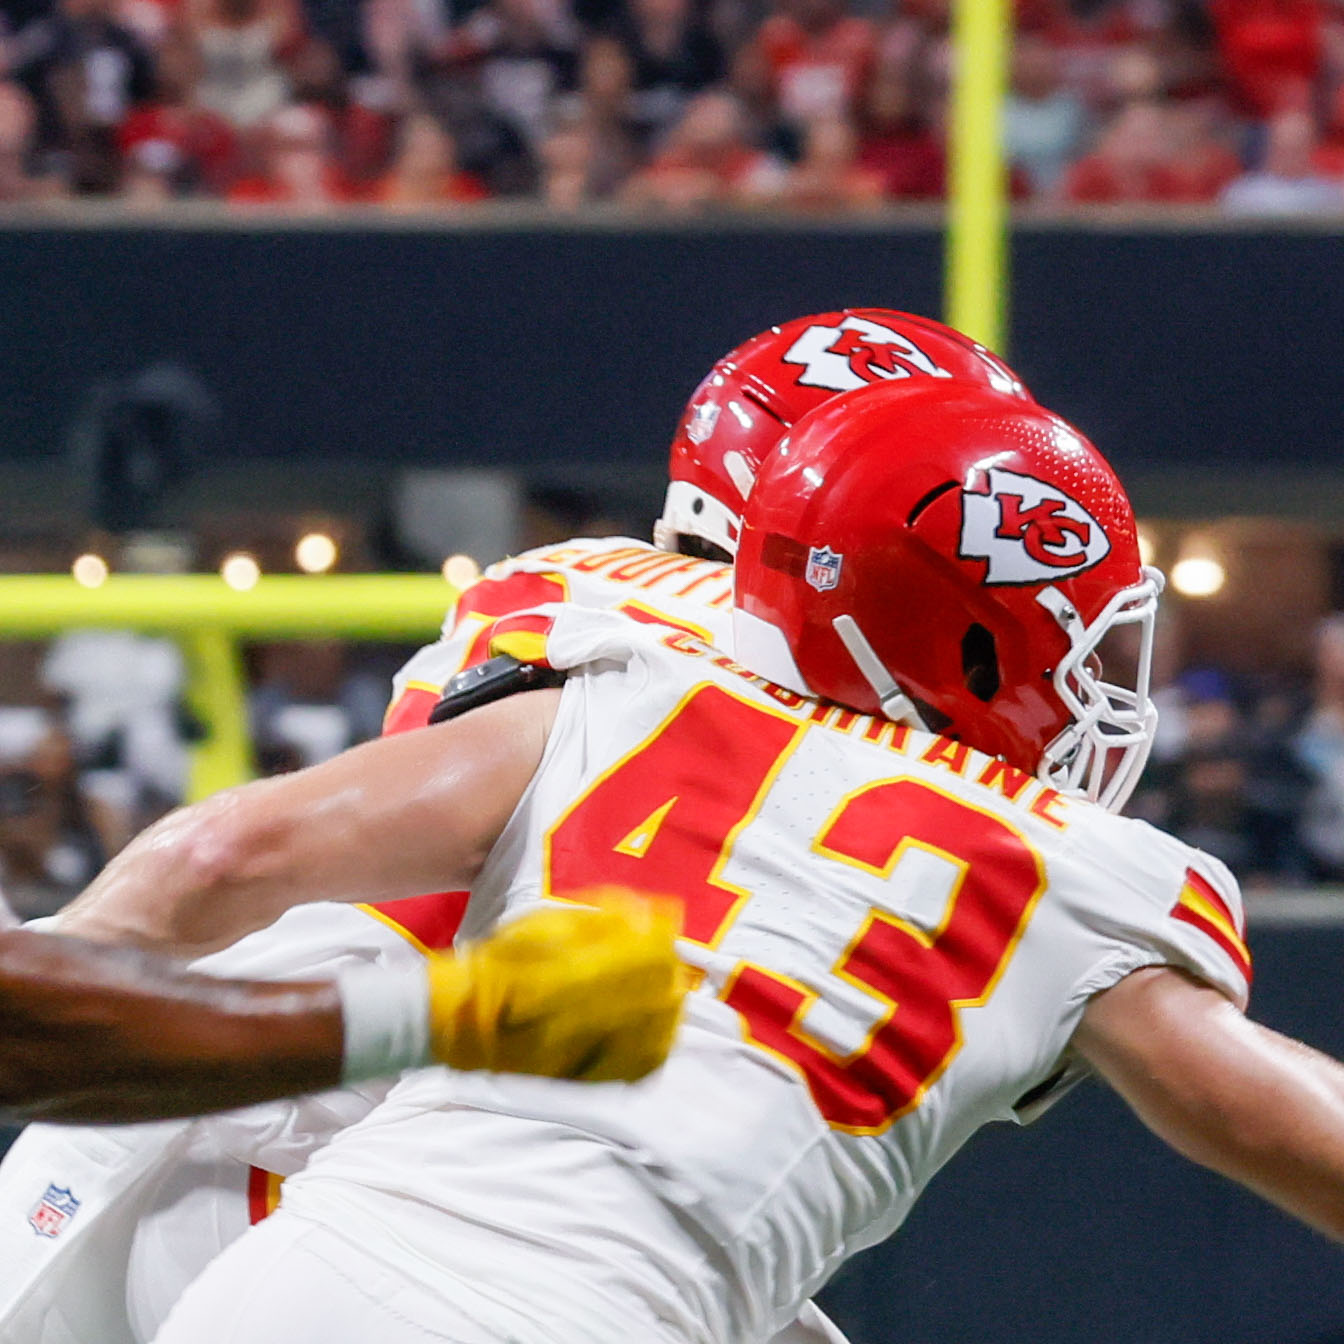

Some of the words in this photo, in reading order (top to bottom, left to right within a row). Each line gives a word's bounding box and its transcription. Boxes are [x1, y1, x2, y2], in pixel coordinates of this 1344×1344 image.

[826, 328, 917, 383] KC
[994, 491, 1090, 568] KC
[546, 682, 1047, 1137] 43
